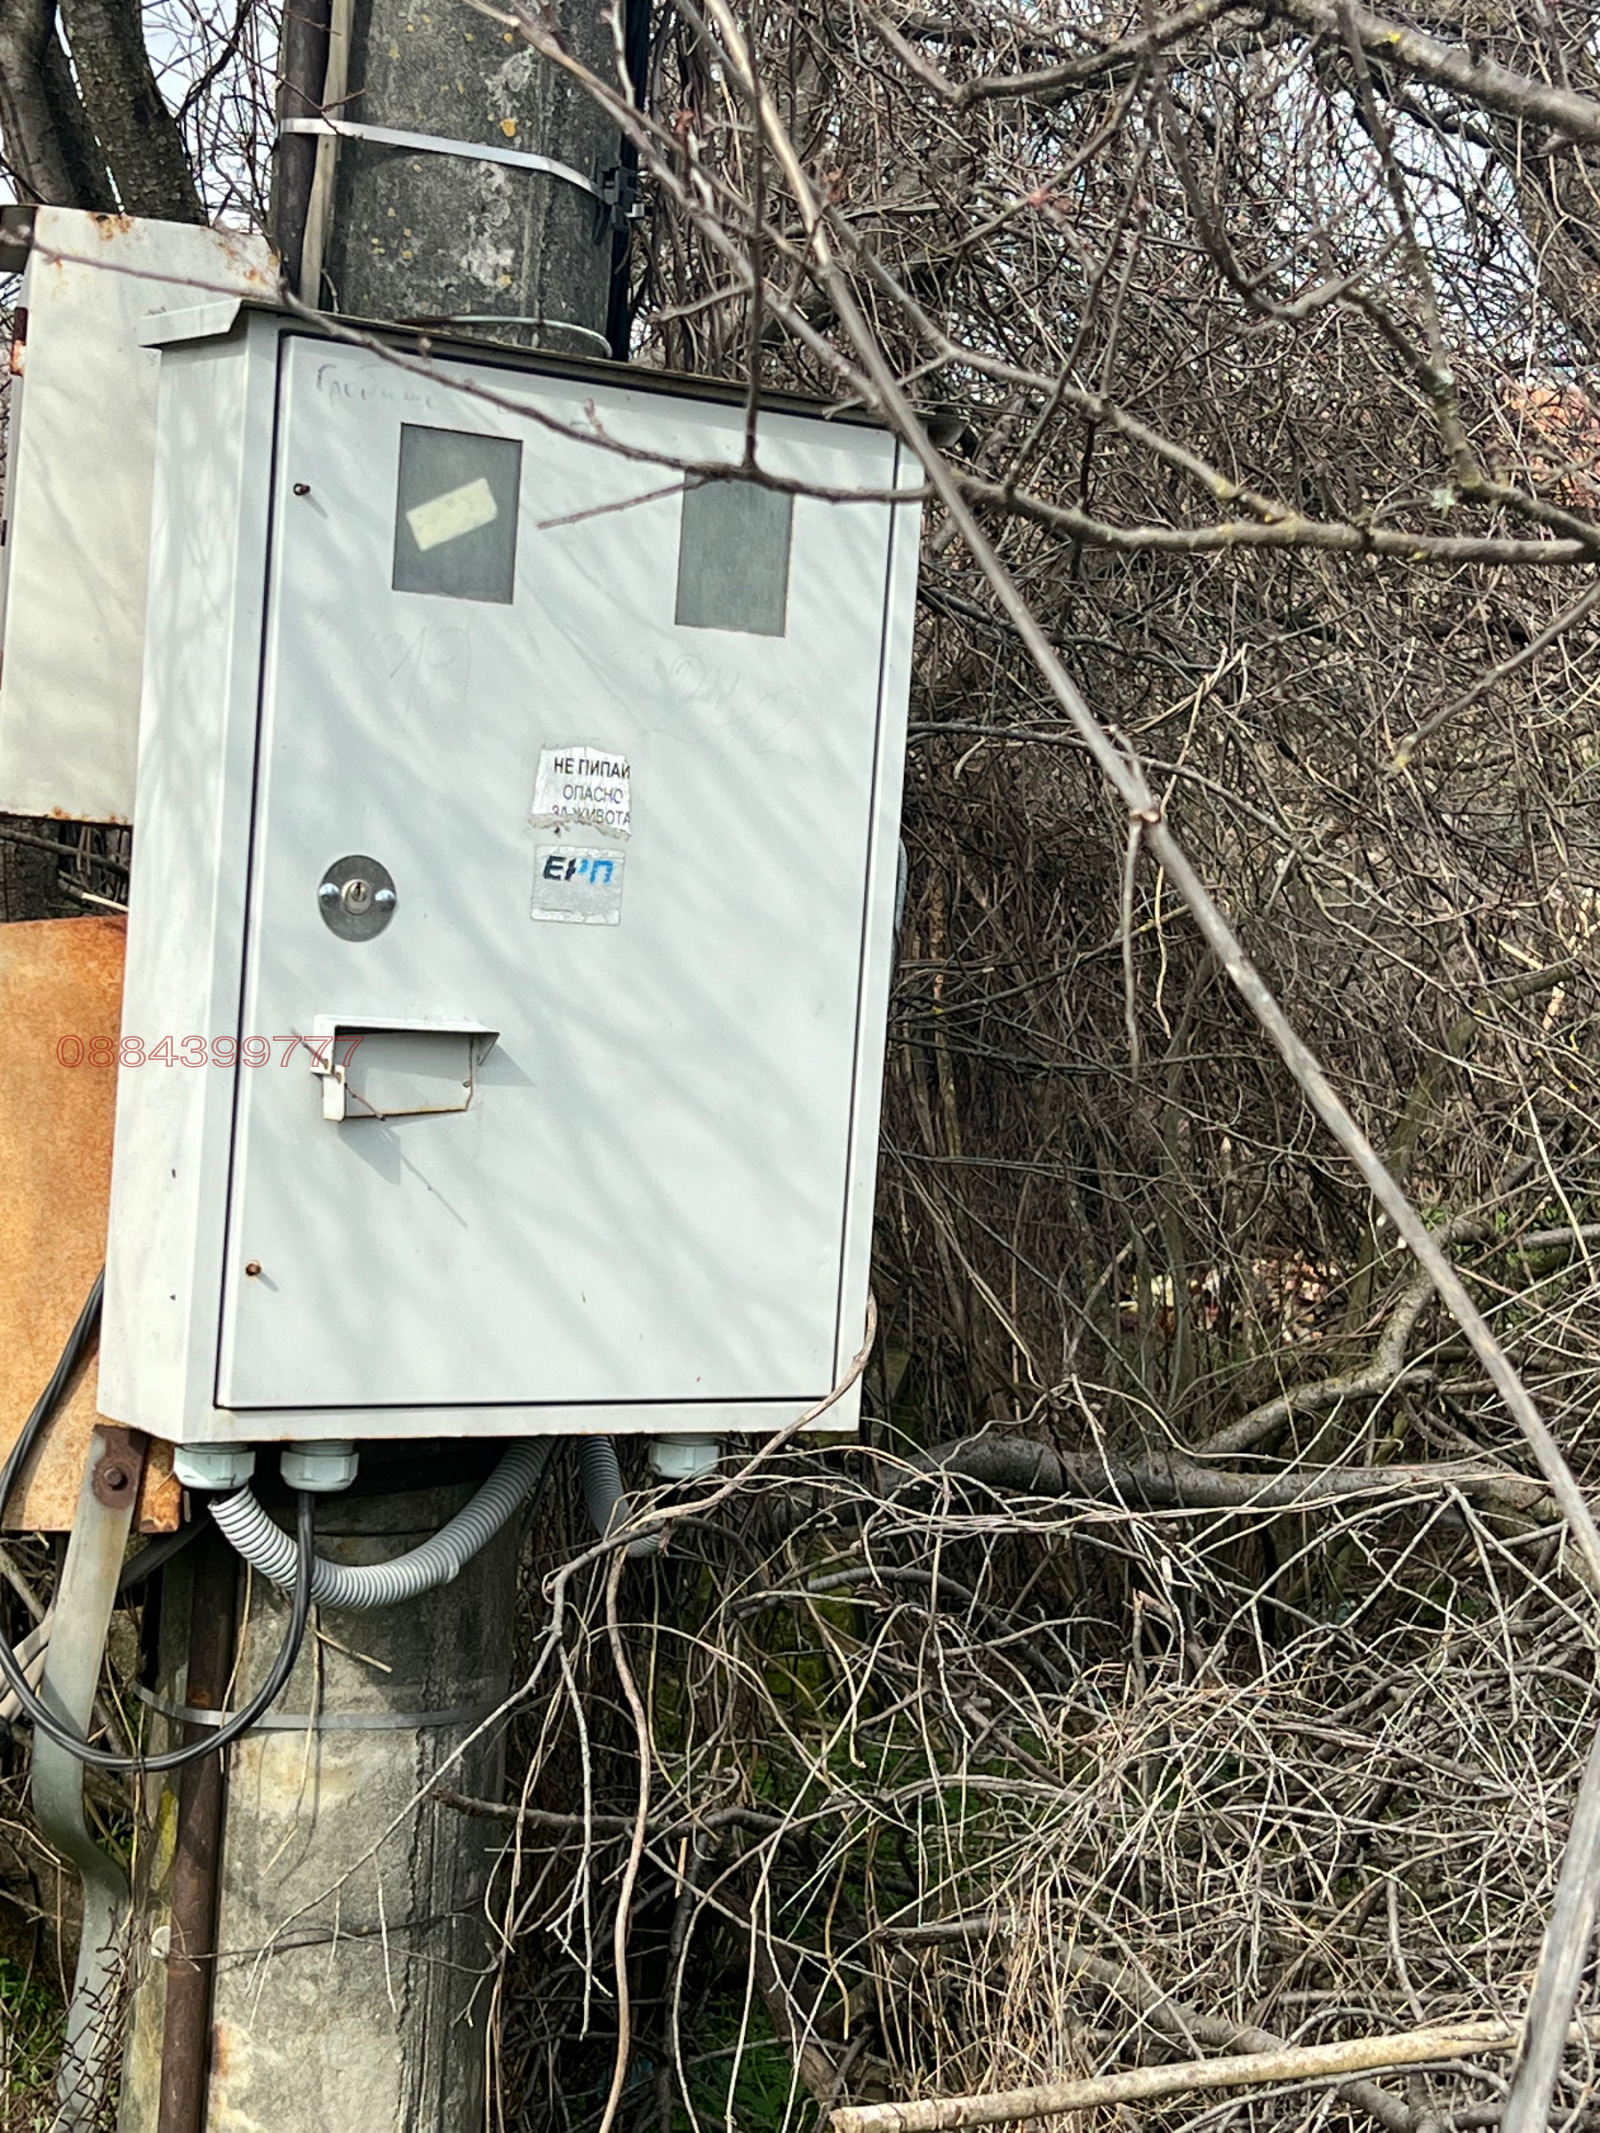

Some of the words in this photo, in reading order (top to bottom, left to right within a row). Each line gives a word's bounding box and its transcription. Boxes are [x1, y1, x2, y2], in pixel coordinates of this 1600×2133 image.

[554, 757, 574, 775] НЕ
[562, 784, 623, 804] ОПАСНО
[573, 807, 631, 825] ЖИВОТА
